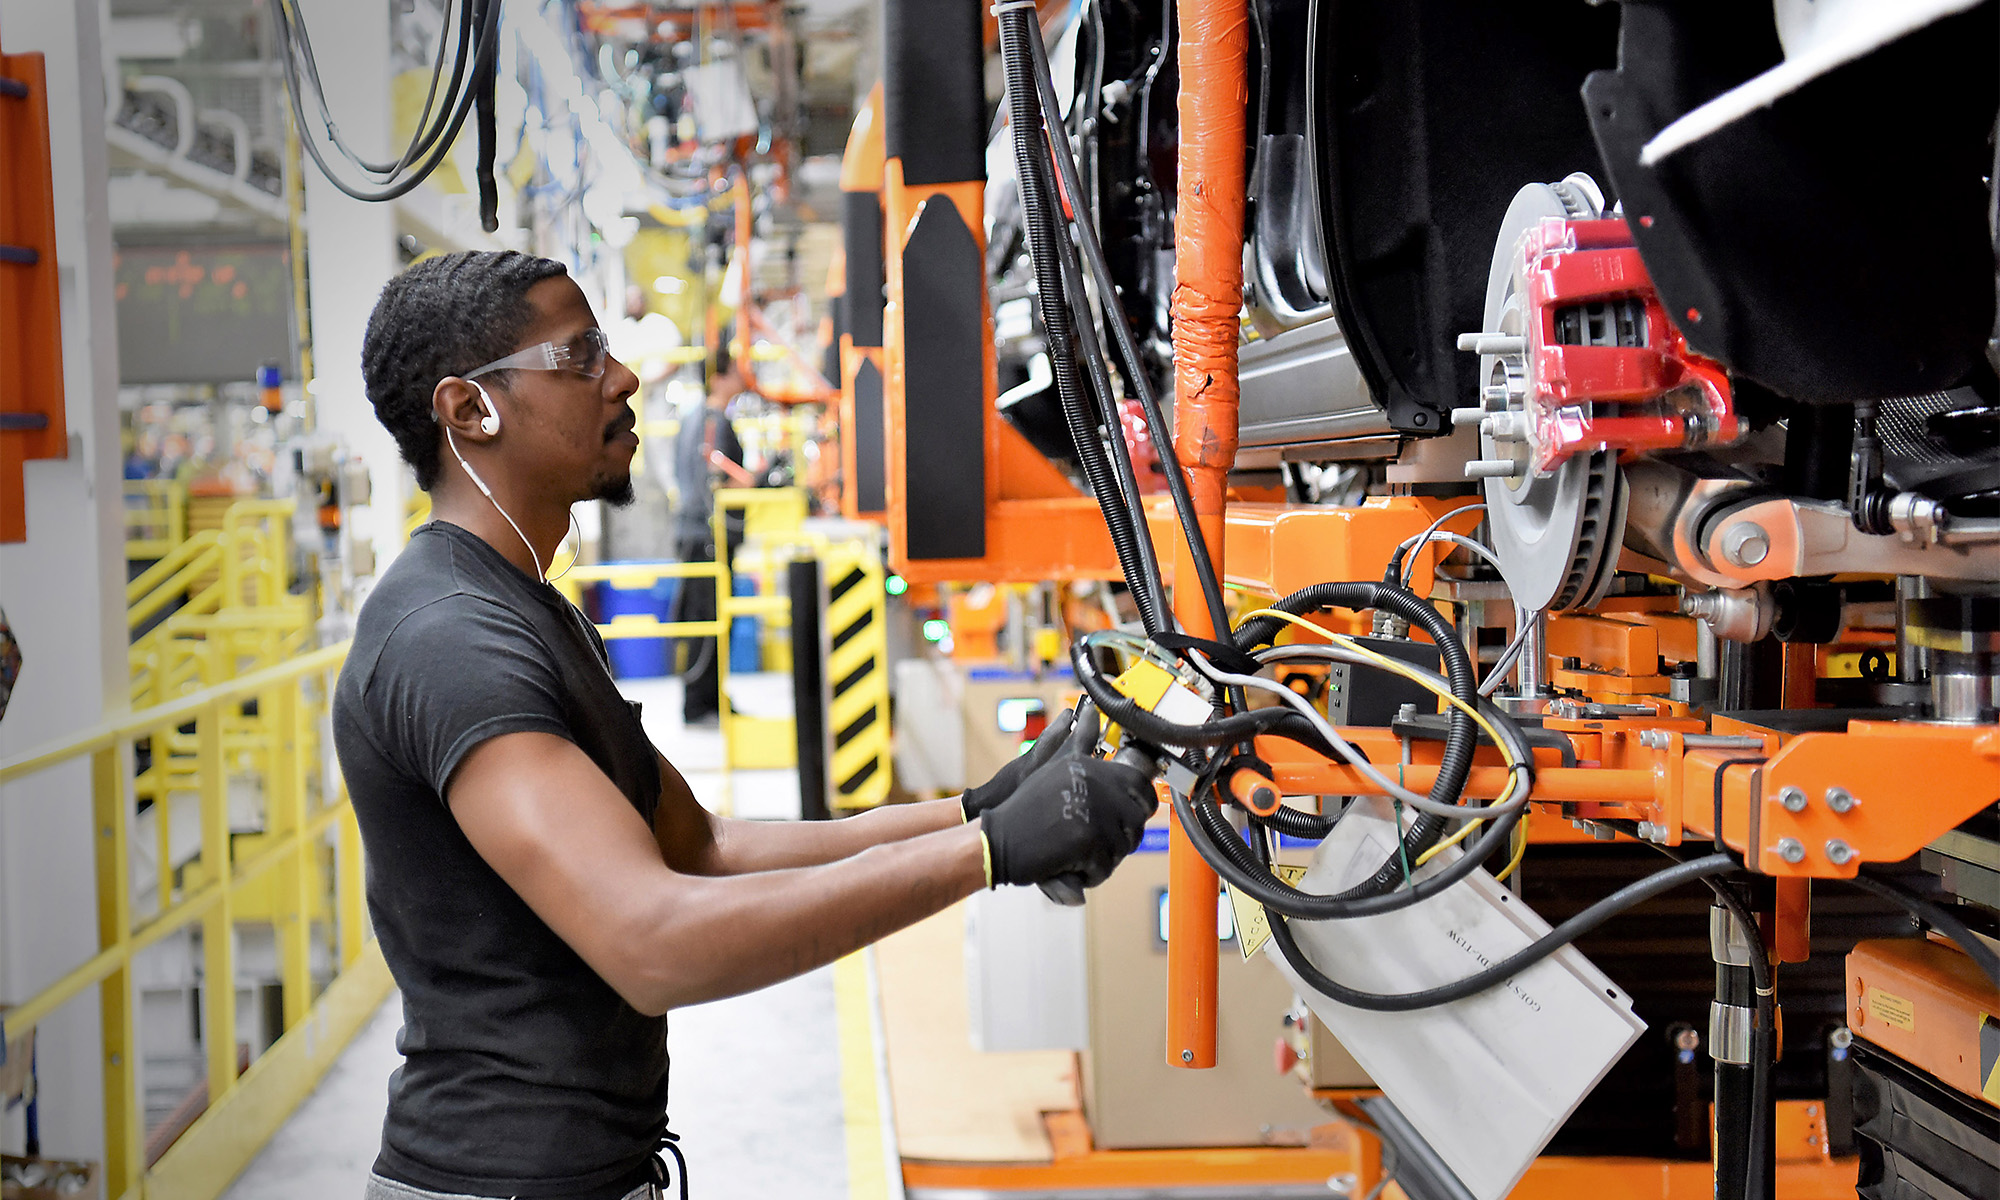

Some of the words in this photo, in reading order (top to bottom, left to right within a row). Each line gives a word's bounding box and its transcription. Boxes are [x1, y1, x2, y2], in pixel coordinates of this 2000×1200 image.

[1060, 789, 1073, 820] PU
[1447, 929, 1497, 970] DL-T13W
[1513, 979, 1542, 1013] GOES
